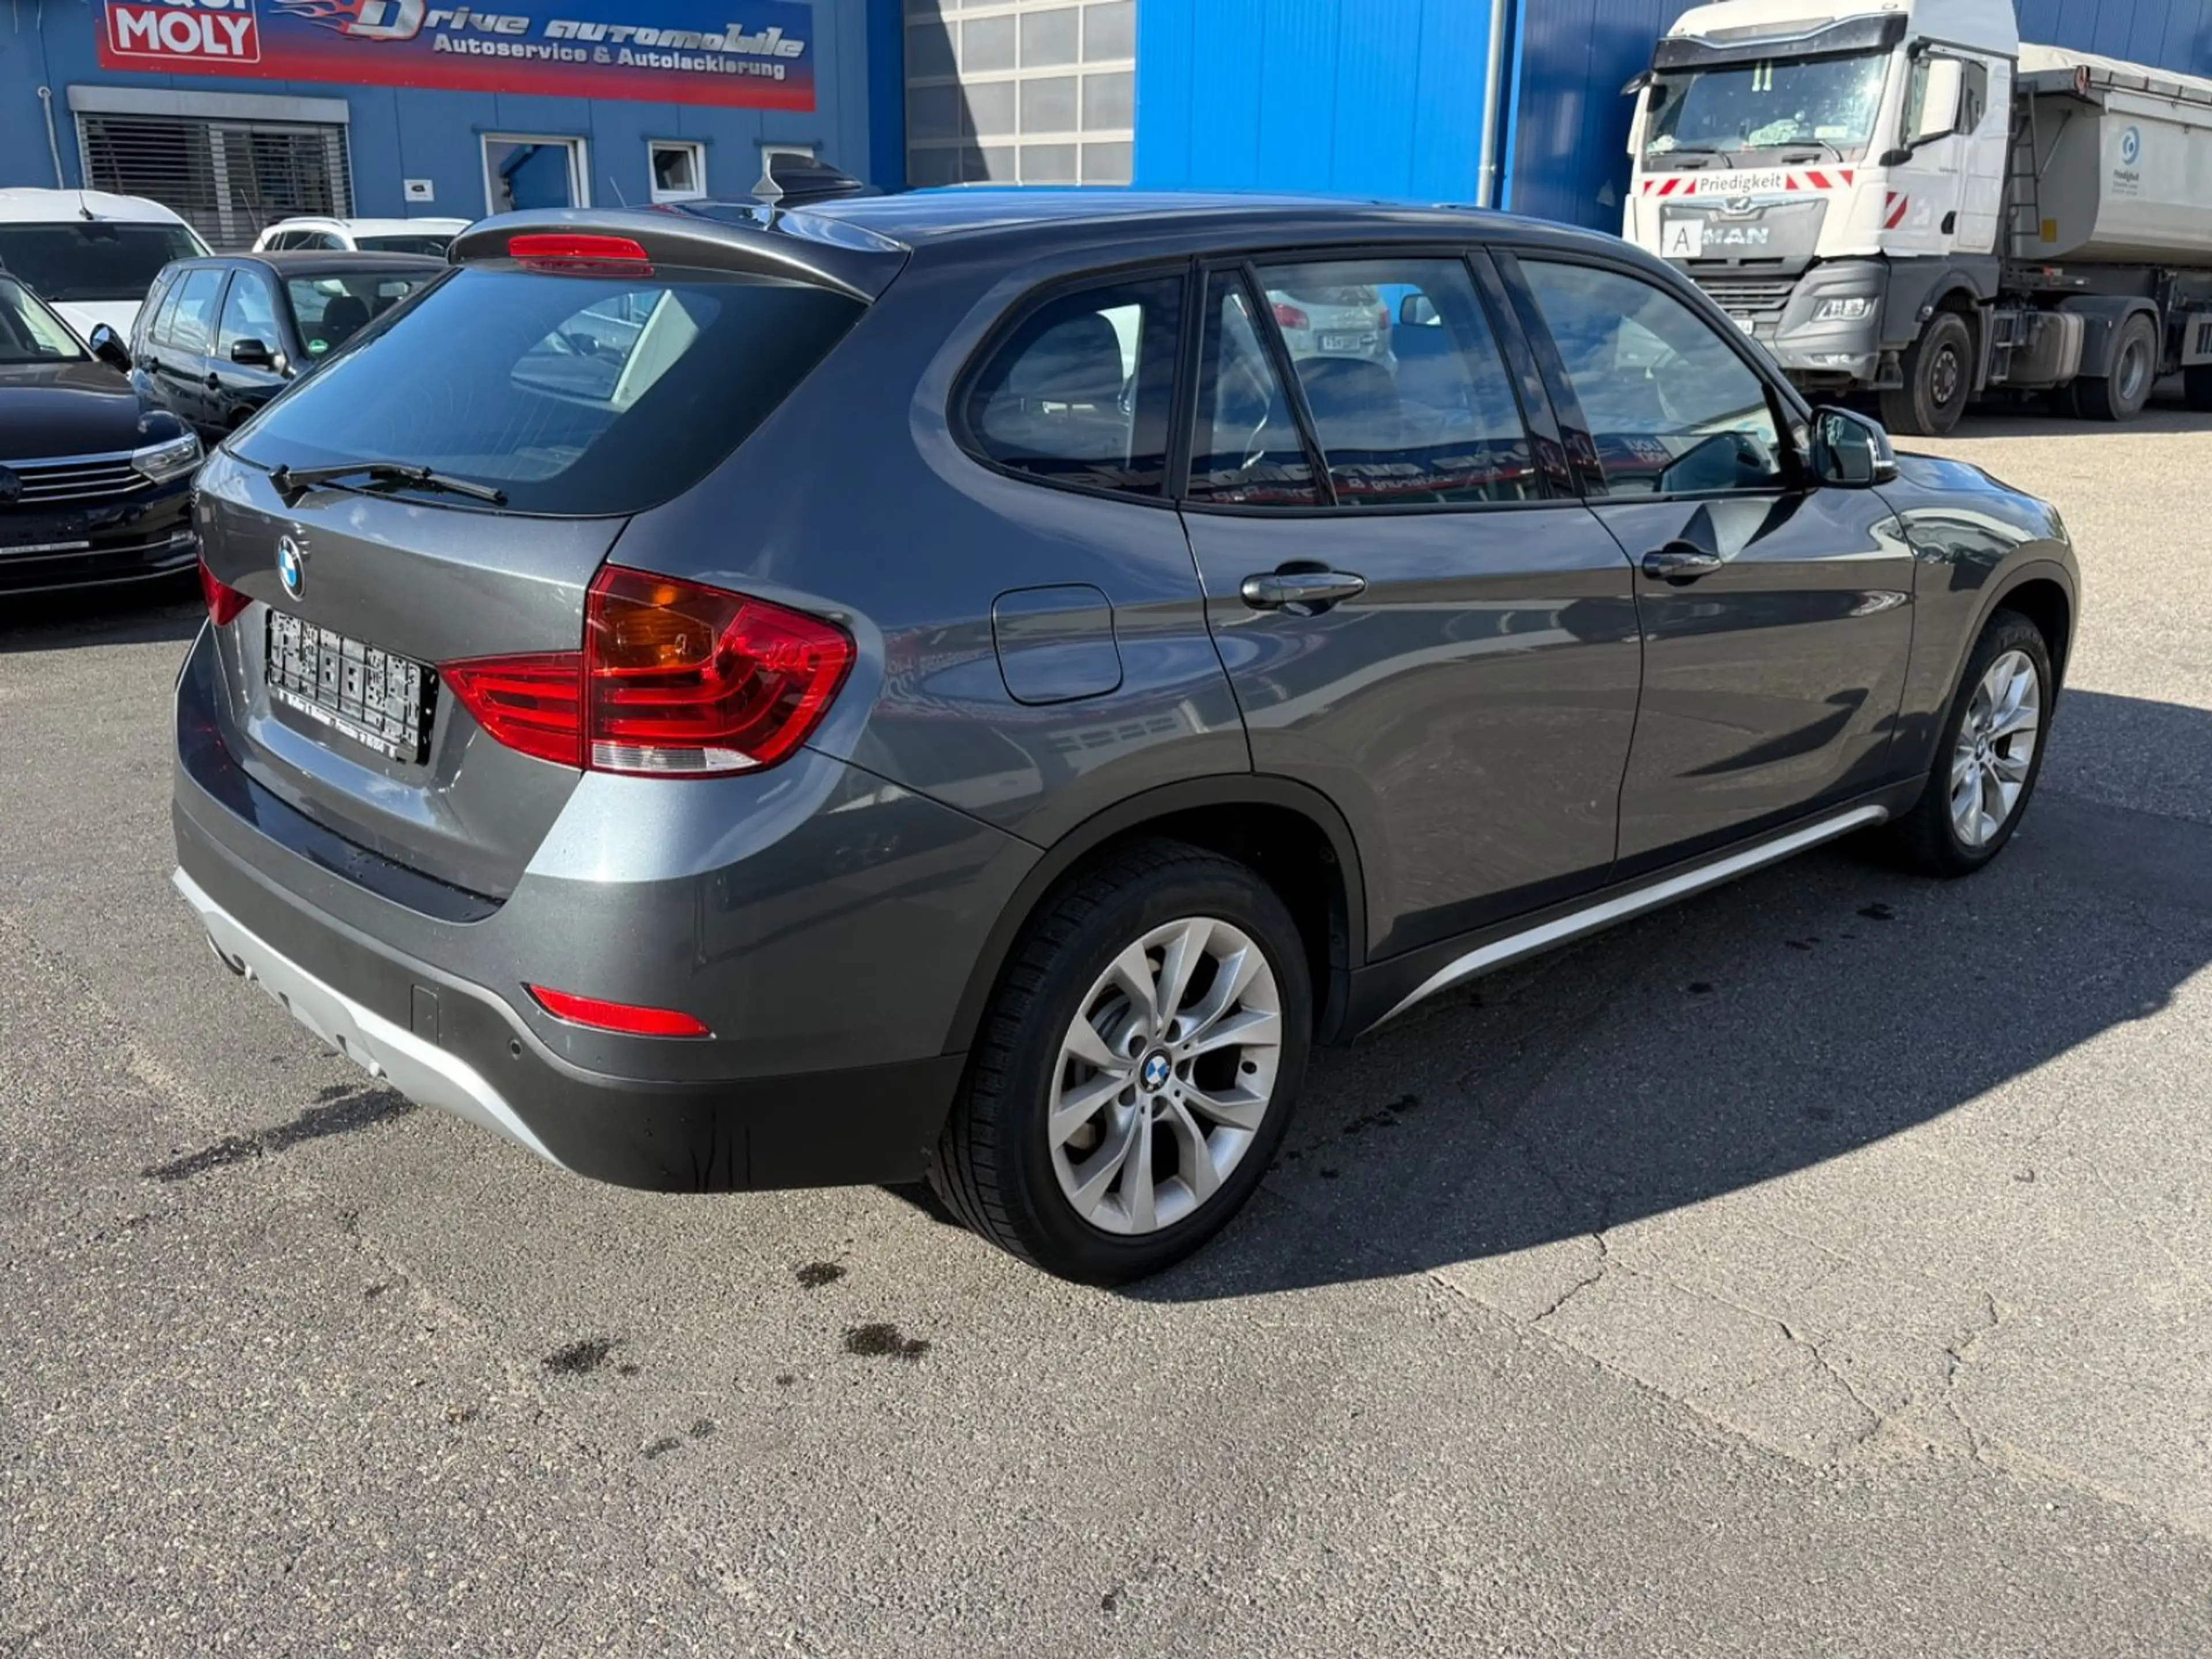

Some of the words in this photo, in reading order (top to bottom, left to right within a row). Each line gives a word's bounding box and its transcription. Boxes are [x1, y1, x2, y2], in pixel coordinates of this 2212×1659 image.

[116, 8, 252, 55] MOLY
[347, 0, 530, 36] Drive
[434, 33, 586, 62] Autoservice
[593, 46, 611, 64] &
[618, 47, 785, 80] Autolackierung
[1700, 175, 1781, 192] Priedigkeit
[1673, 226, 1690, 252] A
[1701, 228, 1770, 245] MAN
